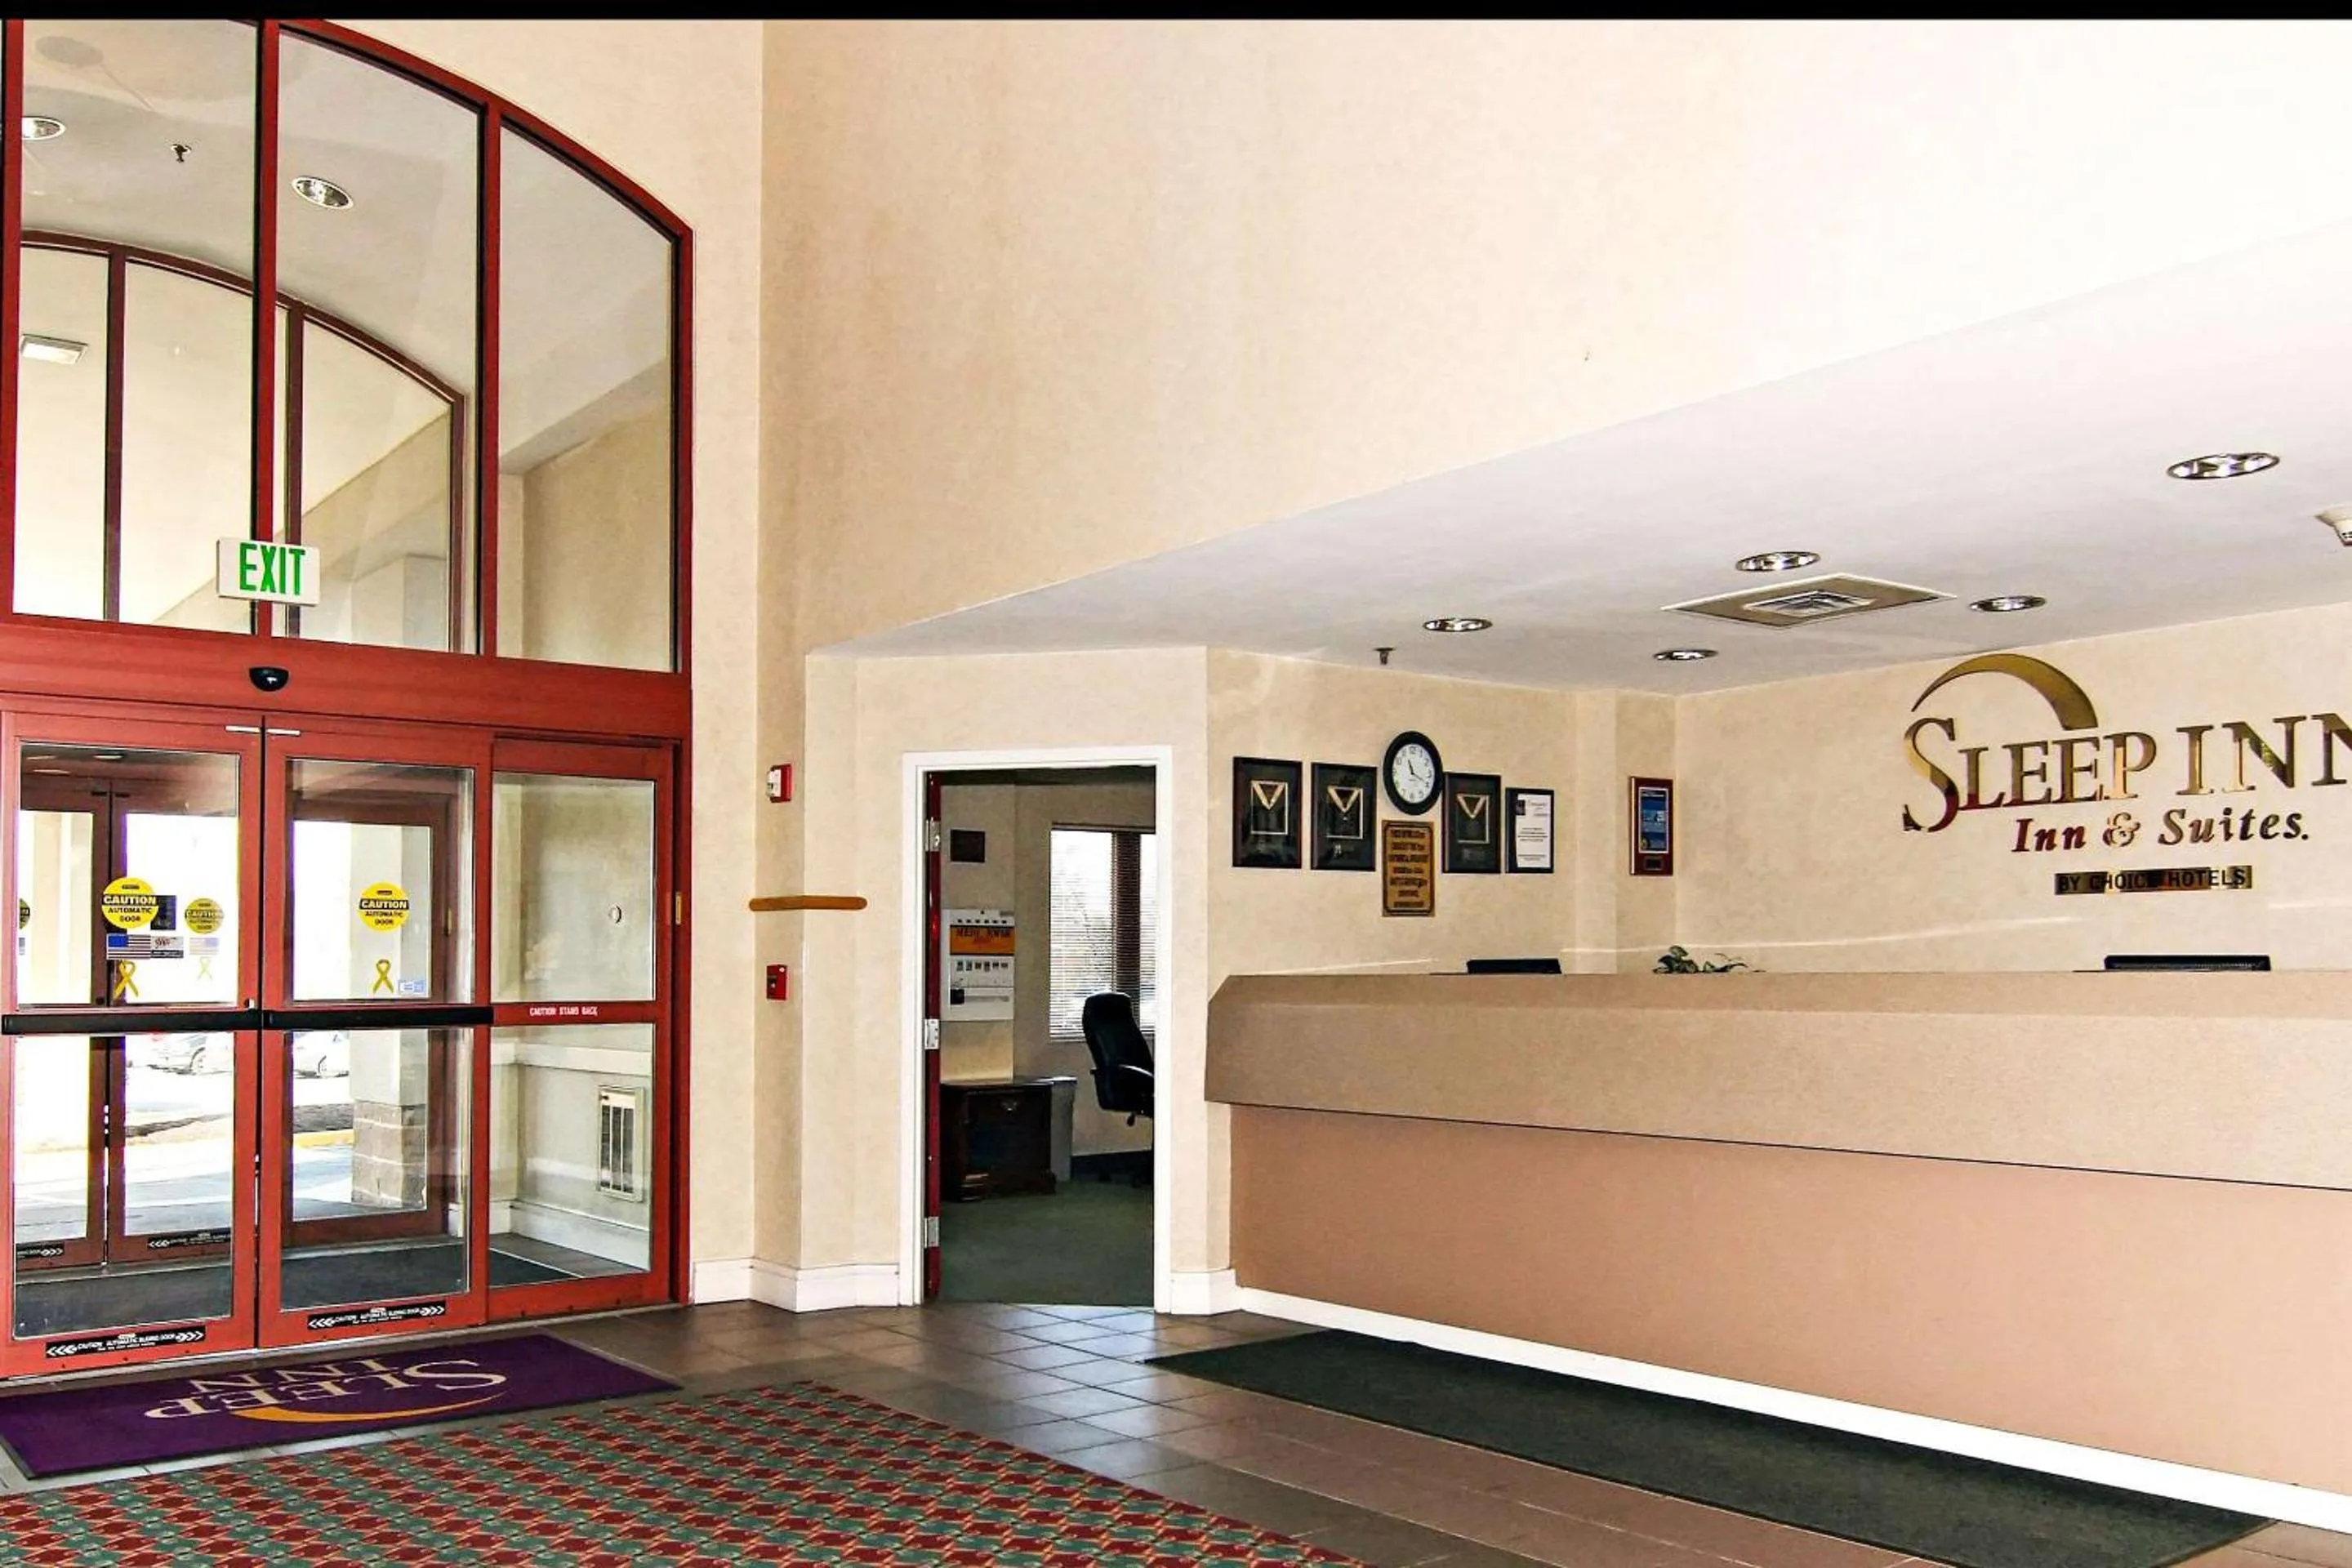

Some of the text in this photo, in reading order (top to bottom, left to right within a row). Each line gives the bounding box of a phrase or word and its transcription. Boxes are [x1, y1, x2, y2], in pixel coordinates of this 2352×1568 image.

[238, 542, 305, 595] EXIT
[1902, 717, 2157, 833] SLEEP
[2011, 817, 2086, 853] Inn
[2102, 812, 2140, 848] &
[2059, 869, 2246, 891] BY CHOIC HOTELS
[104, 896, 156, 905] CAUTION
[361, 900, 407, 909] CAUTION
[529, 1006, 557, 1017] CAUTION
[144, 1359, 507, 1419] SLEEP
[189, 1358, 399, 1394] INN
